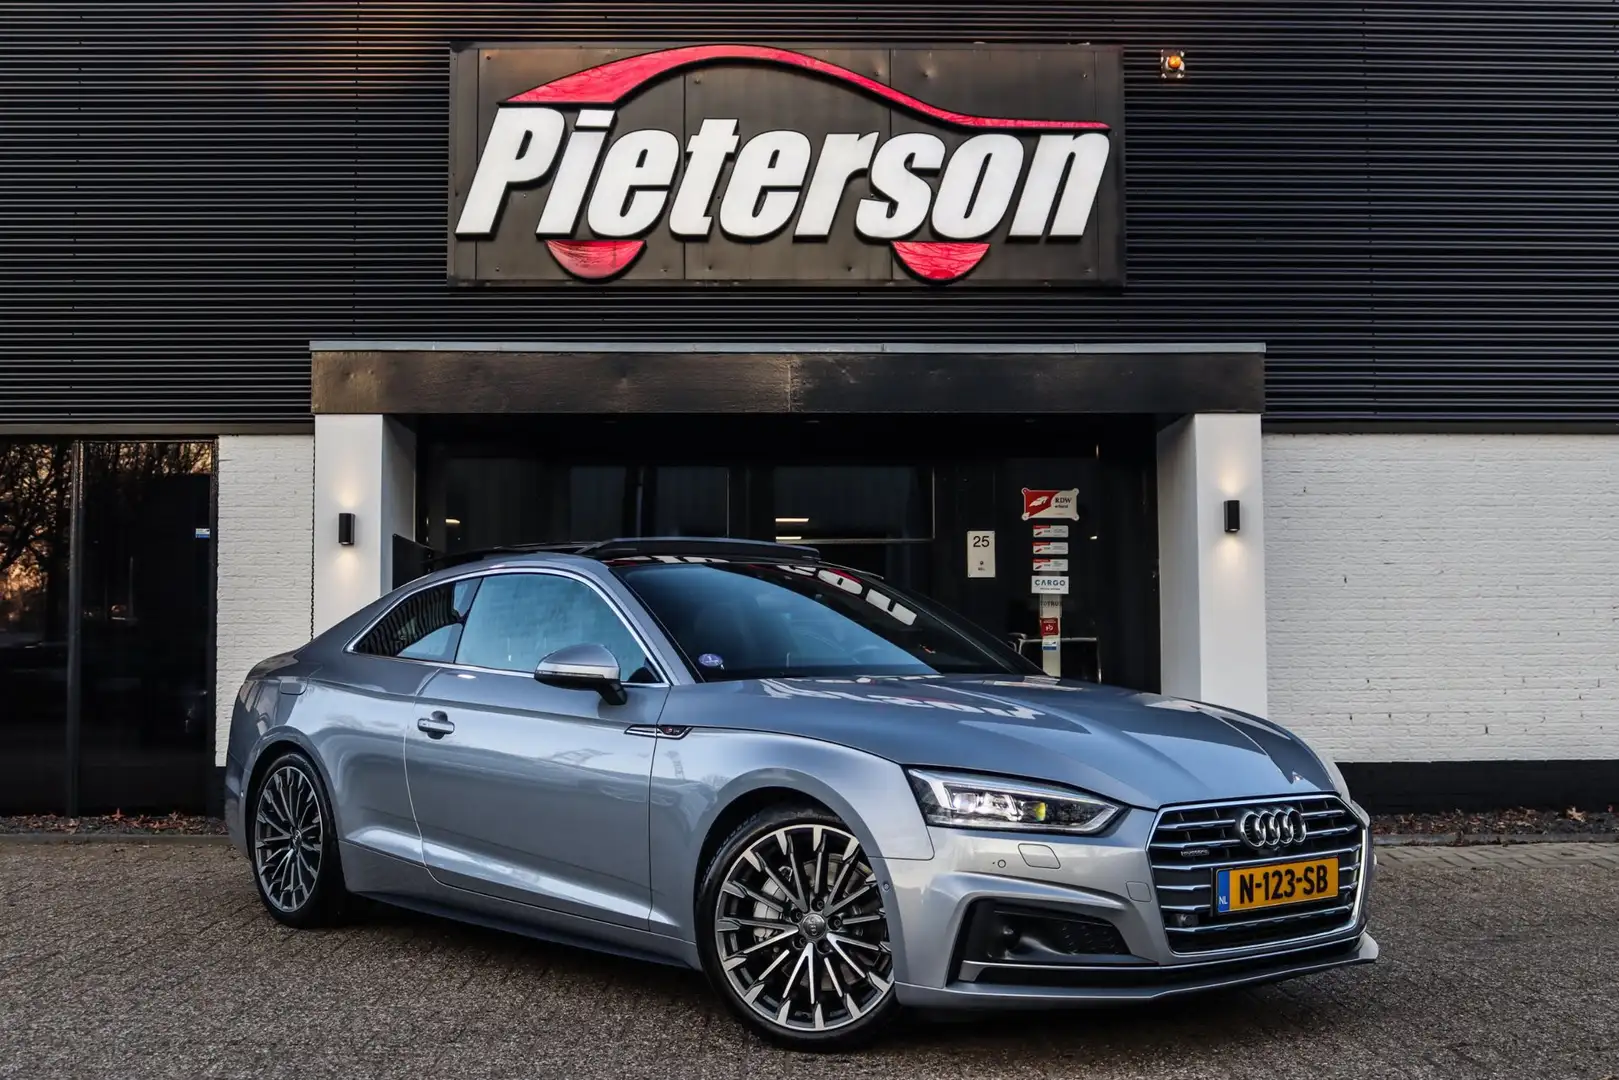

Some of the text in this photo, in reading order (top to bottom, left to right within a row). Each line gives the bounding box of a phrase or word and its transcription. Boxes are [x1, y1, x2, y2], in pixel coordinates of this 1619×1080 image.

[455, 106, 1111, 239] Pieterson
[973, 535, 990, 548] 25
[1239, 864, 1328, 905] N-123-SB
[1218, 895, 1229, 905] NL
